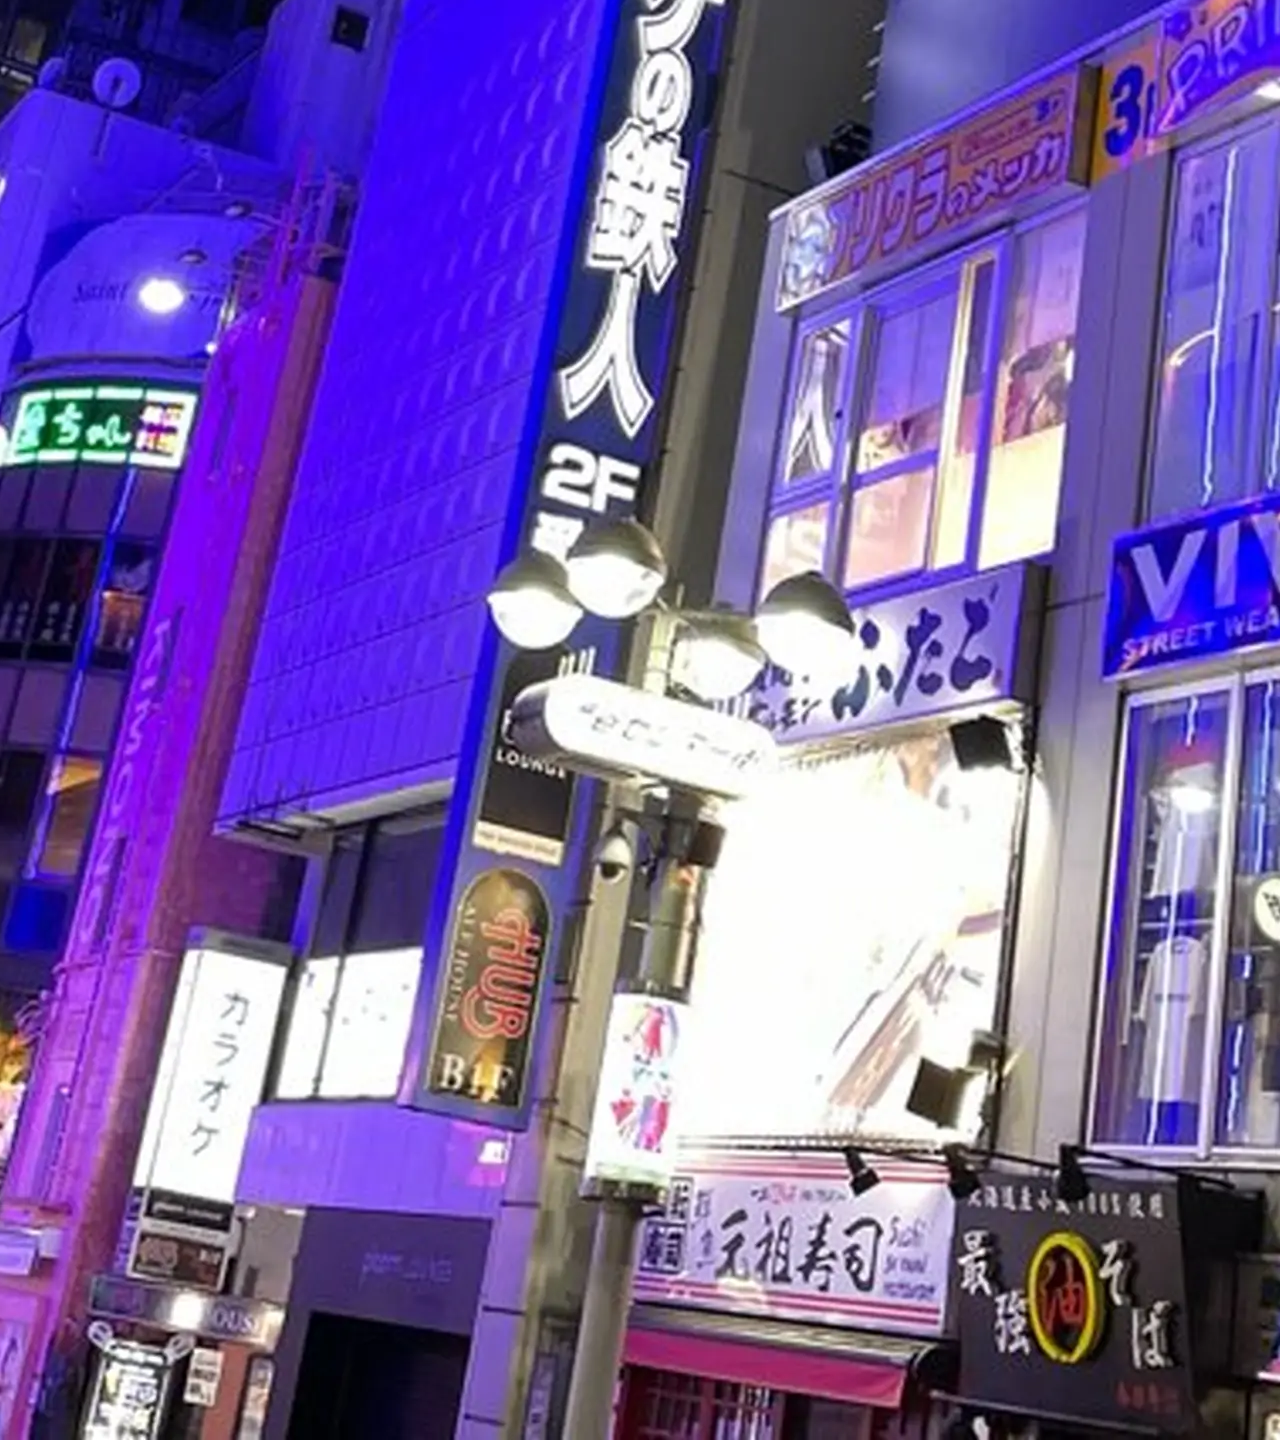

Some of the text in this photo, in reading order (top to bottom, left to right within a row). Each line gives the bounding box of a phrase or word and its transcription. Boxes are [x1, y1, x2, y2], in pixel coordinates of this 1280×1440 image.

[542, 442, 640, 512] 2F
[1122, 617, 1214, 661] STREET
[460, 907, 542, 1040] HUB
[190, 990, 252, 1158] カラオケ
[717, 1208, 884, 1293] 元祖寿司
